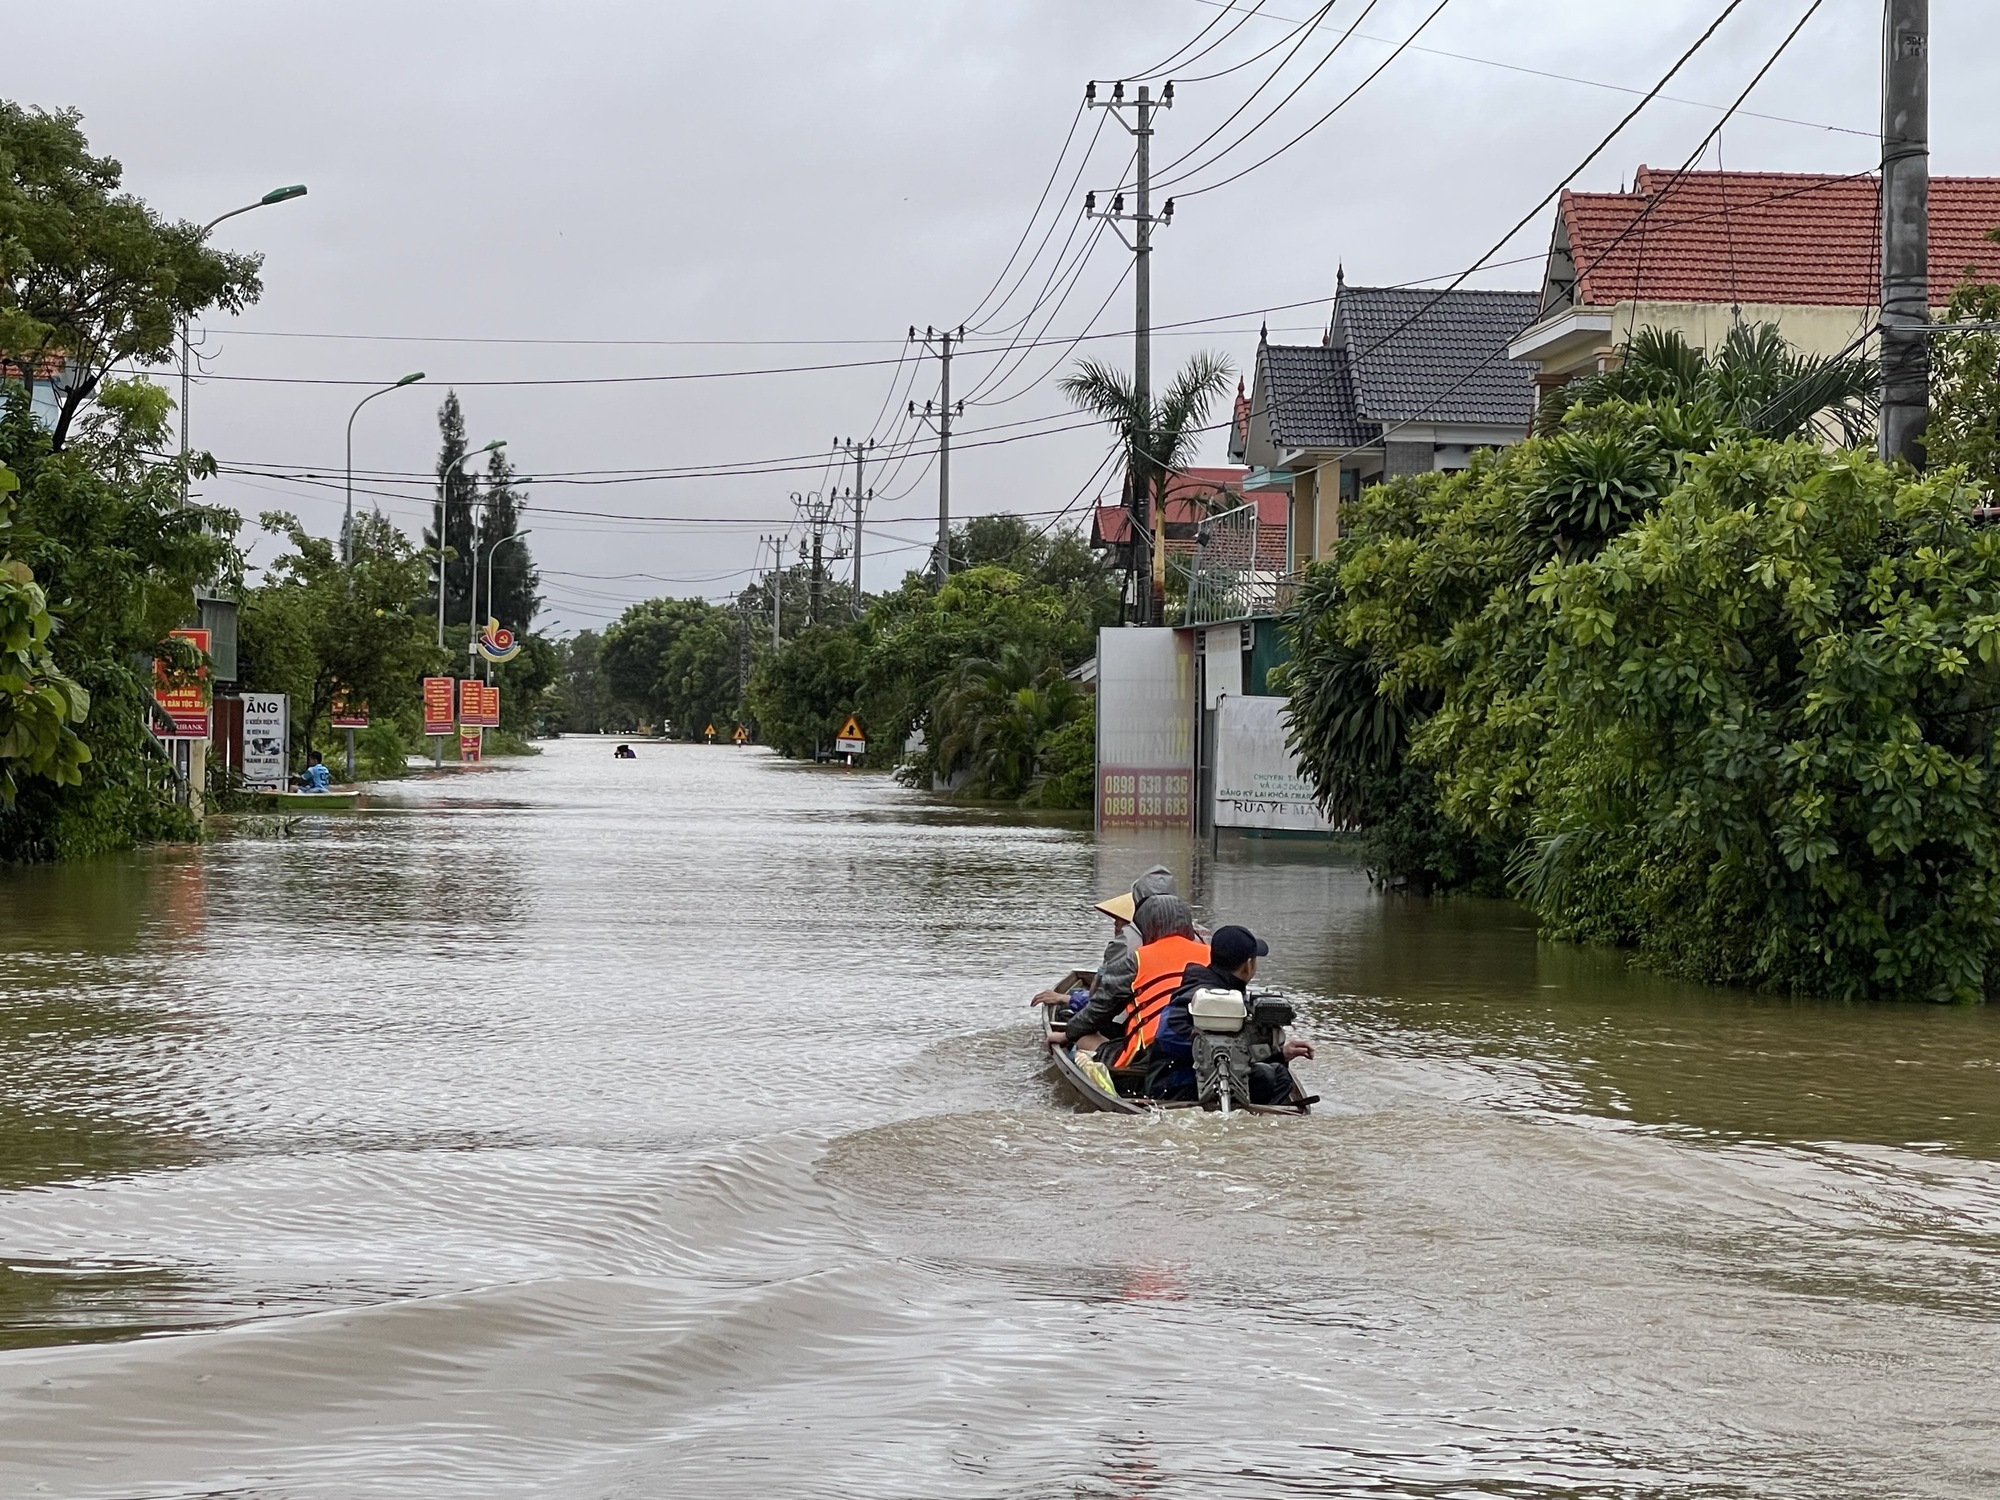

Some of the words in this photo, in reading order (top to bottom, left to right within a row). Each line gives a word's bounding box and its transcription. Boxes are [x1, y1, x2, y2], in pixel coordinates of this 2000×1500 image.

[1105, 775, 1135, 794] 0898
[1138, 775, 1161, 794] 638
[1165, 775, 1189, 794] 836
[1104, 797, 1135, 816] 0898
[1138, 797, 1161, 816] 638
[1165, 797, 1188, 816] 683
